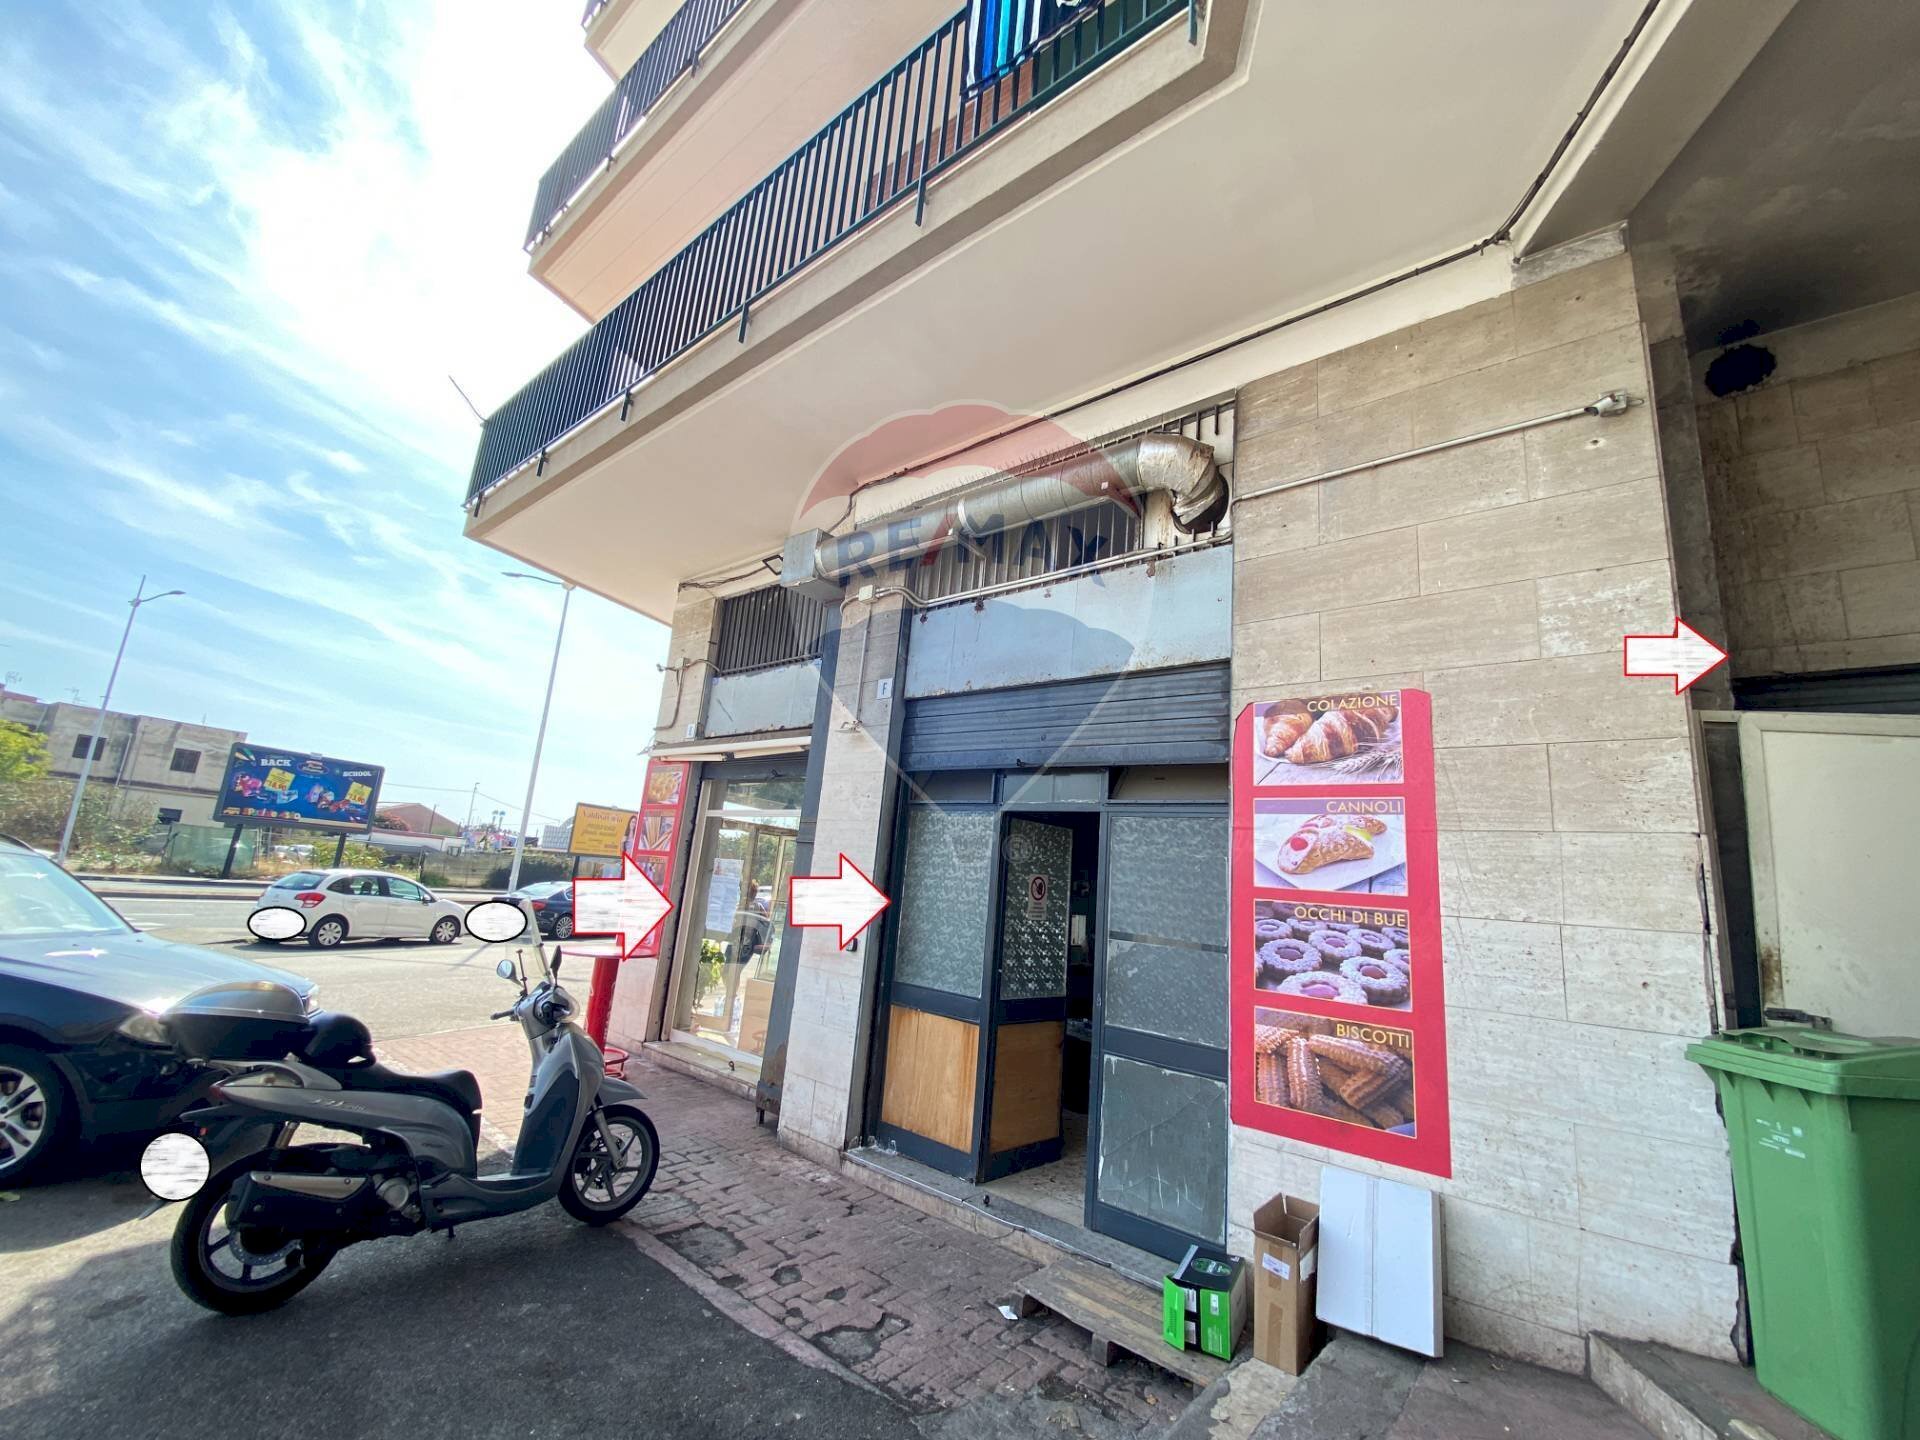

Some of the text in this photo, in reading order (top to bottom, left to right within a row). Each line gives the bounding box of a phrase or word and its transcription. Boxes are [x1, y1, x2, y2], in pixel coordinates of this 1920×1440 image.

[1307, 694, 1398, 712] COLAZIONE
[260, 758, 292, 767] BACK
[1326, 801, 1401, 813] CANNOLI
[1294, 906, 1406, 927] OCCHI DI BUE
[1336, 1023, 1410, 1048] BISCOTTI
